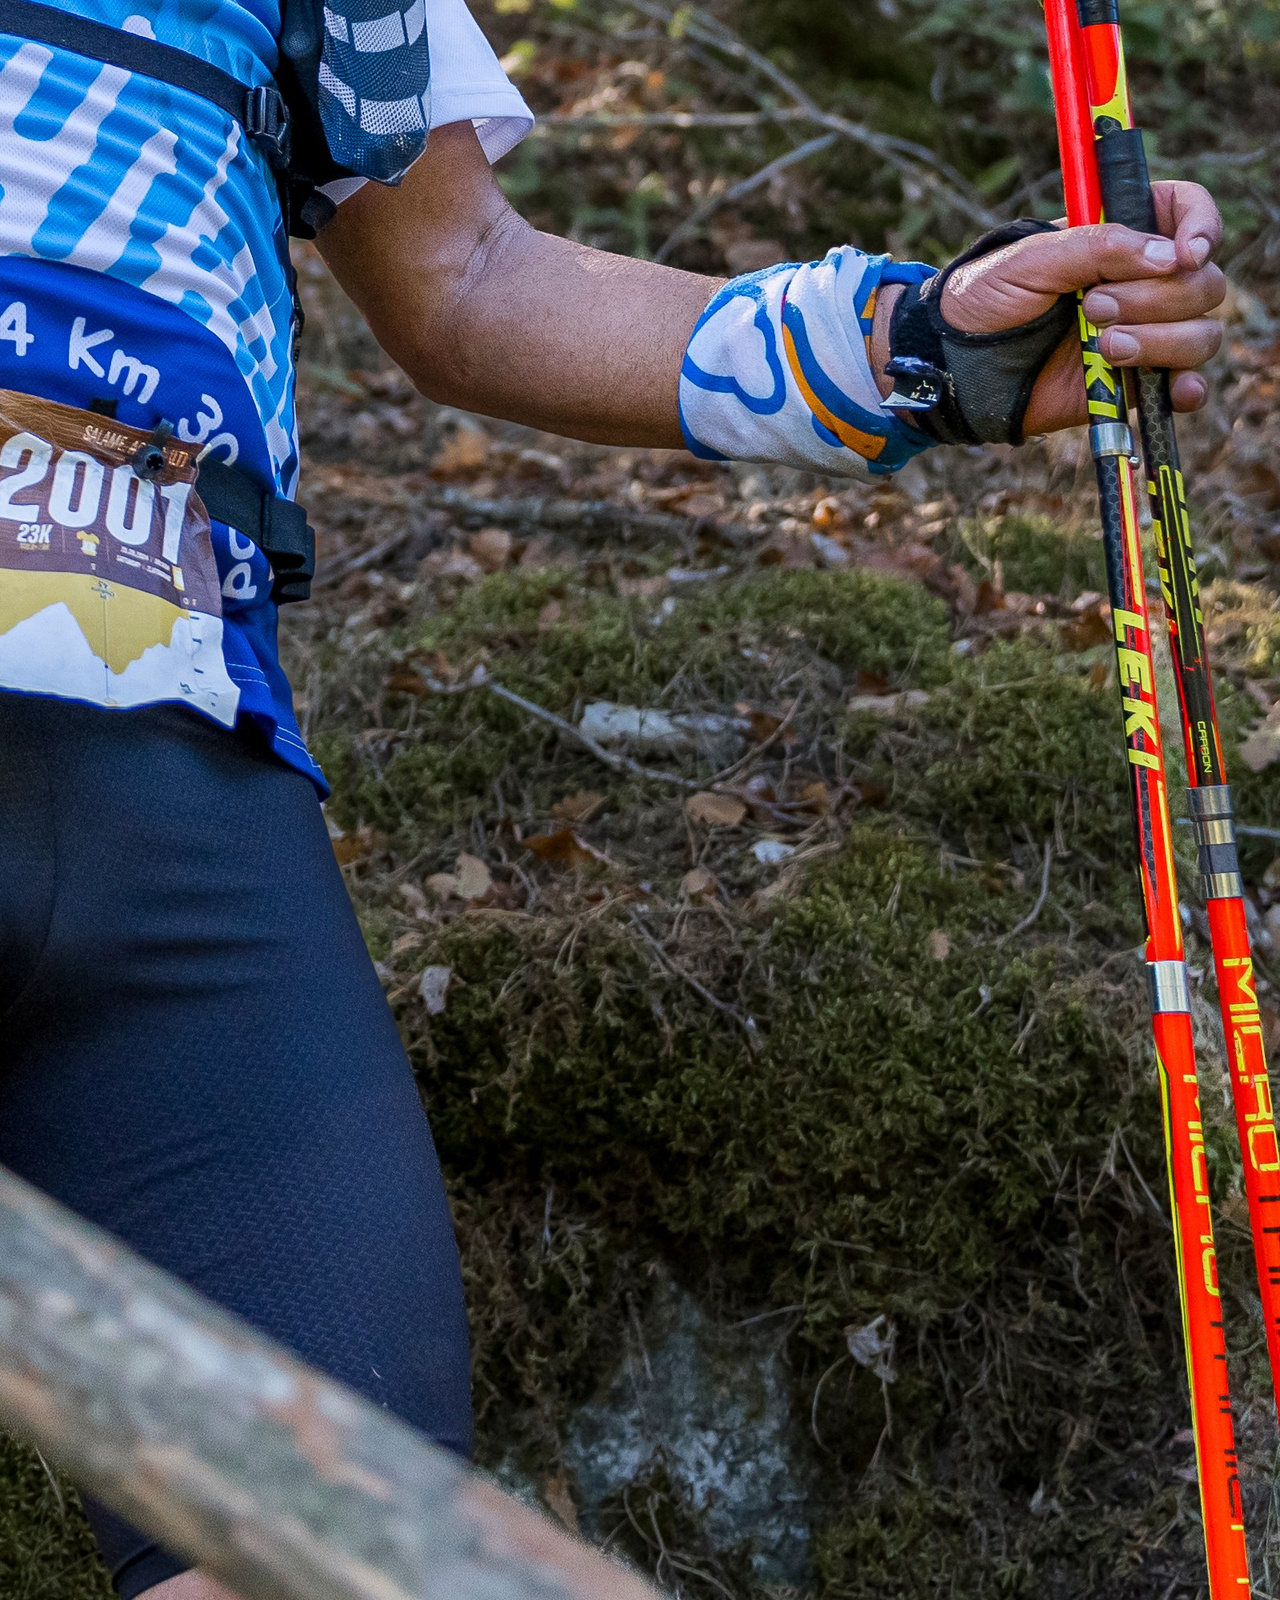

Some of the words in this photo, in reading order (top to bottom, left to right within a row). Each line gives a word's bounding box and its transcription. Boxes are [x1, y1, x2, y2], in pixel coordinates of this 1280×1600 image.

[68, 317, 160, 404] Km
[1076, 289, 1118, 418] EKI
[16, 523, 54, 544] 23K
[1114, 608, 1160, 771] LEKI
[1197, 720, 1213, 773] CARBON
